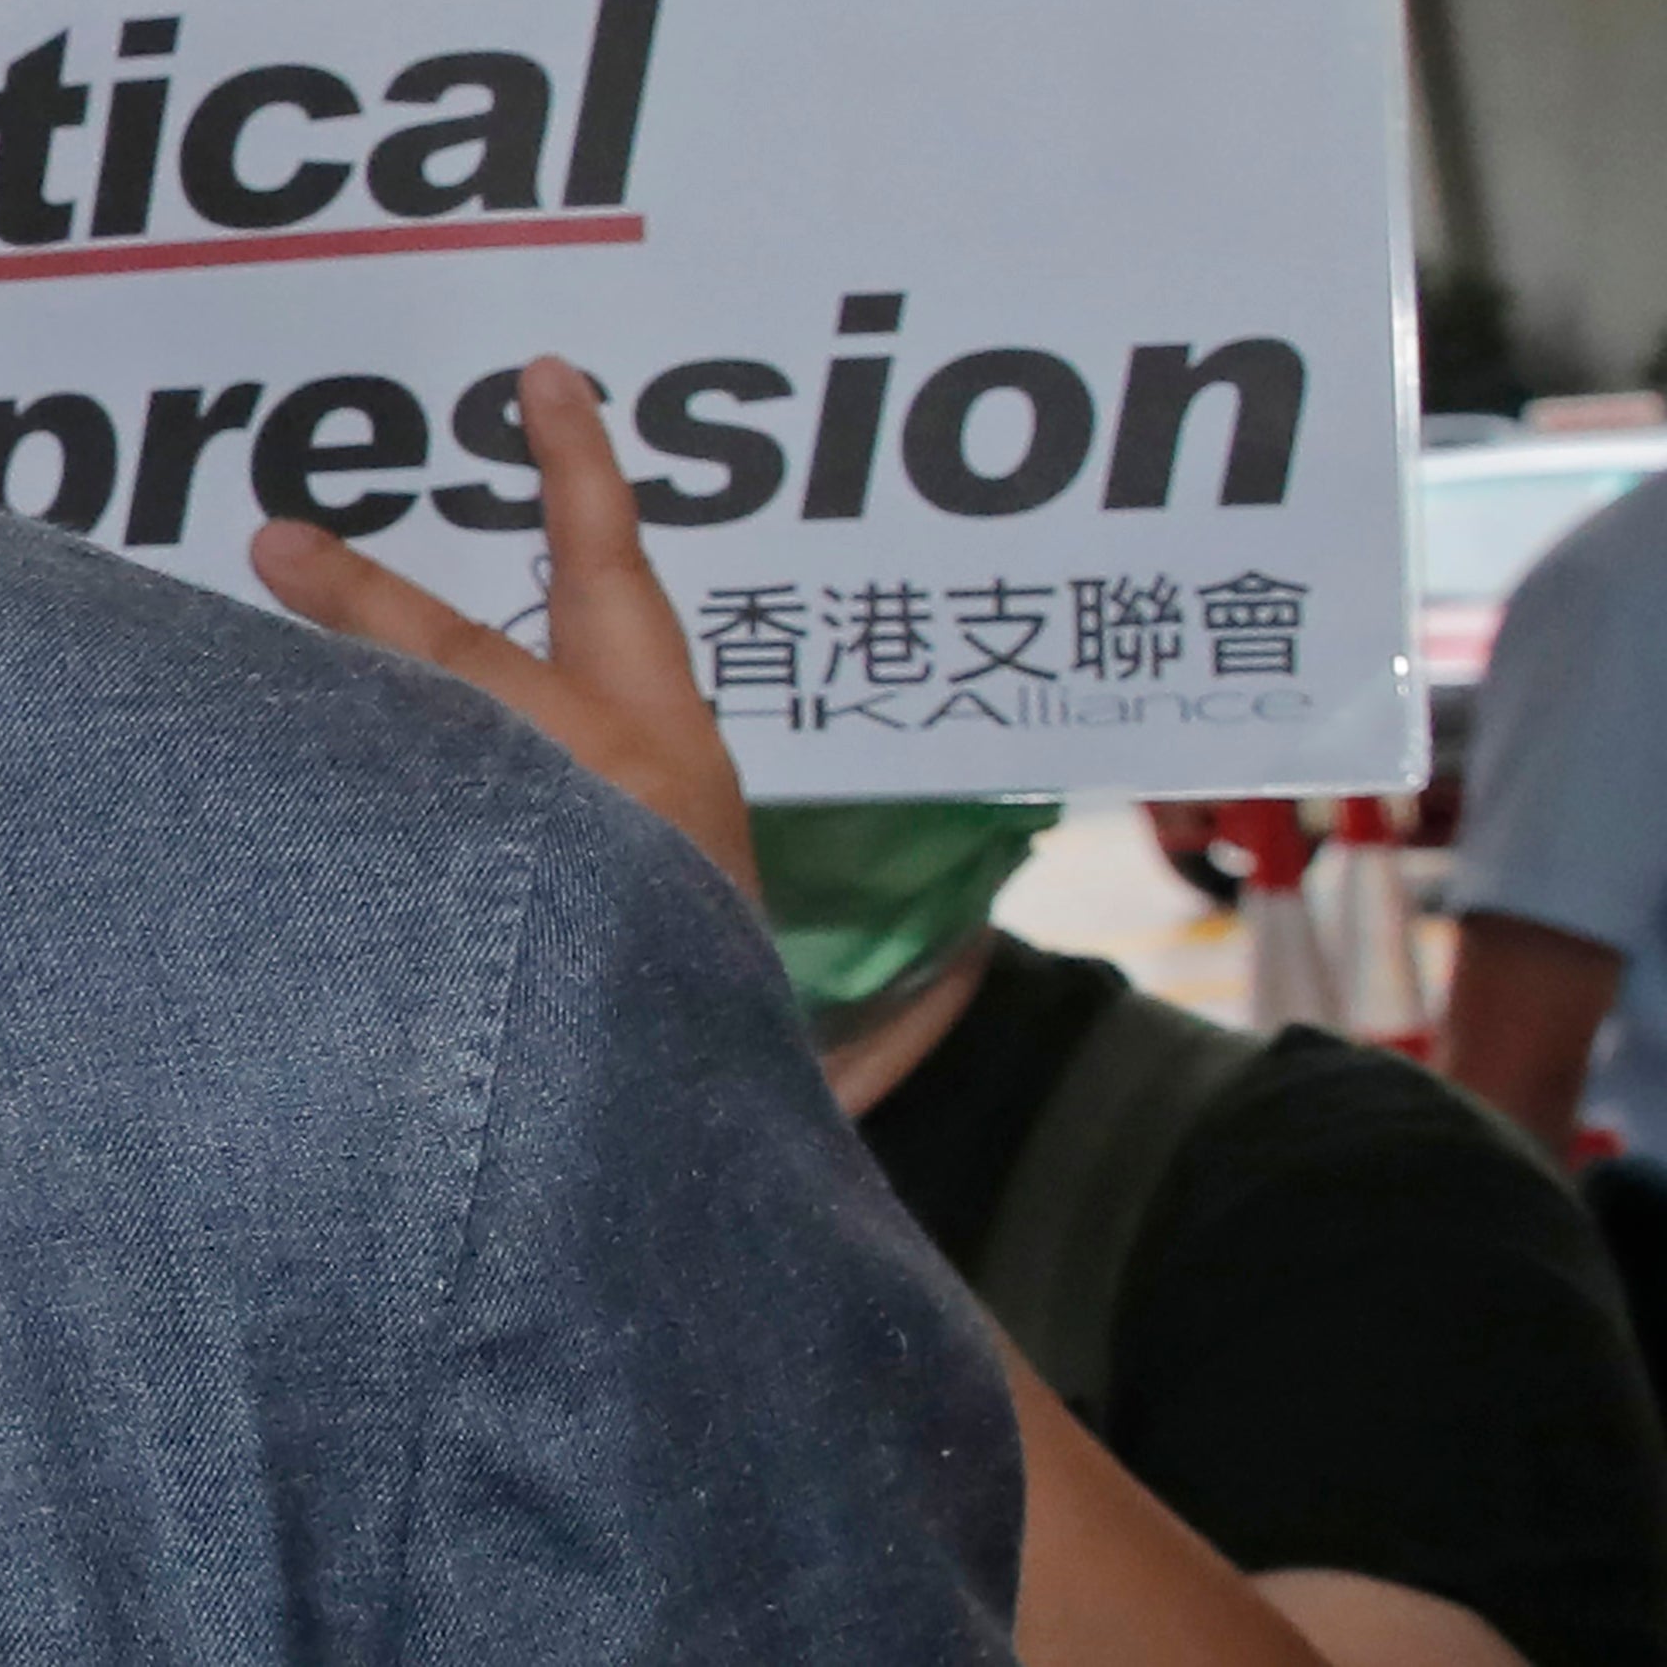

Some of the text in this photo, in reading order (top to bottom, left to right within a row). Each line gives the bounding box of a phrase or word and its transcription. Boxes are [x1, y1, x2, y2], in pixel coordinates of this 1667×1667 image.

[698, 570, 1310, 690] 香港支聯會
